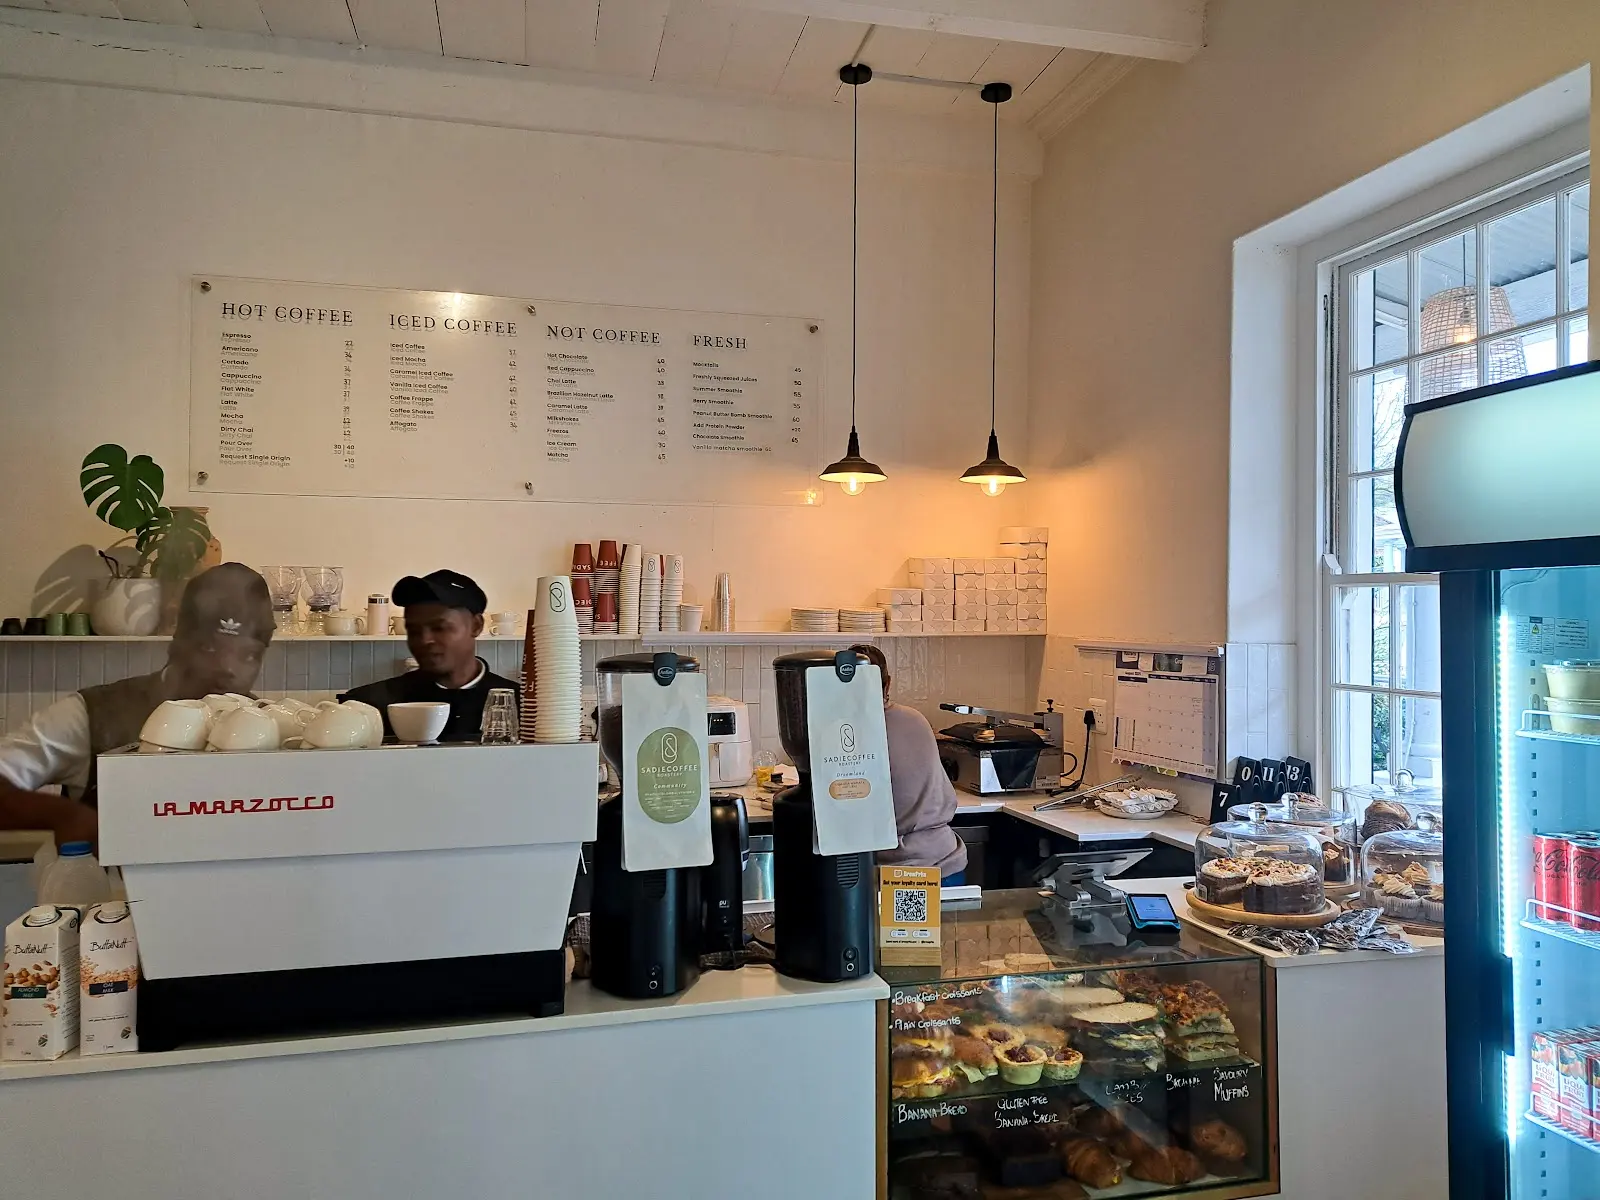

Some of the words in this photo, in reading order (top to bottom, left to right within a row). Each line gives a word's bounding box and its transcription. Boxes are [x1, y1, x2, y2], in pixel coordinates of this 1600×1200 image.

[222, 303, 267, 317] HOT
[275, 306, 353, 323] COFFEE
[390, 314, 436, 329] ICED
[444, 318, 517, 334] COFFEE
[547, 326, 586, 339] NOT
[592, 328, 660, 344] COFFEE
[693, 335, 747, 349] FRESH
[222, 372, 262, 380] Cappuccino
[824, 754, 876, 763] SADIECOFFEE
[641, 765, 698, 774] SADIECOFFEE
[1242, 767, 1252, 781] 0
[1263, 767, 1274, 783] 11
[1287, 765, 1300, 781] 13
[1219, 792, 1229, 808] 7
[154, 803, 177, 817] LA
[895, 990, 940, 1006] Breakfast
[997, 1098, 1030, 1111] GLUTEN
